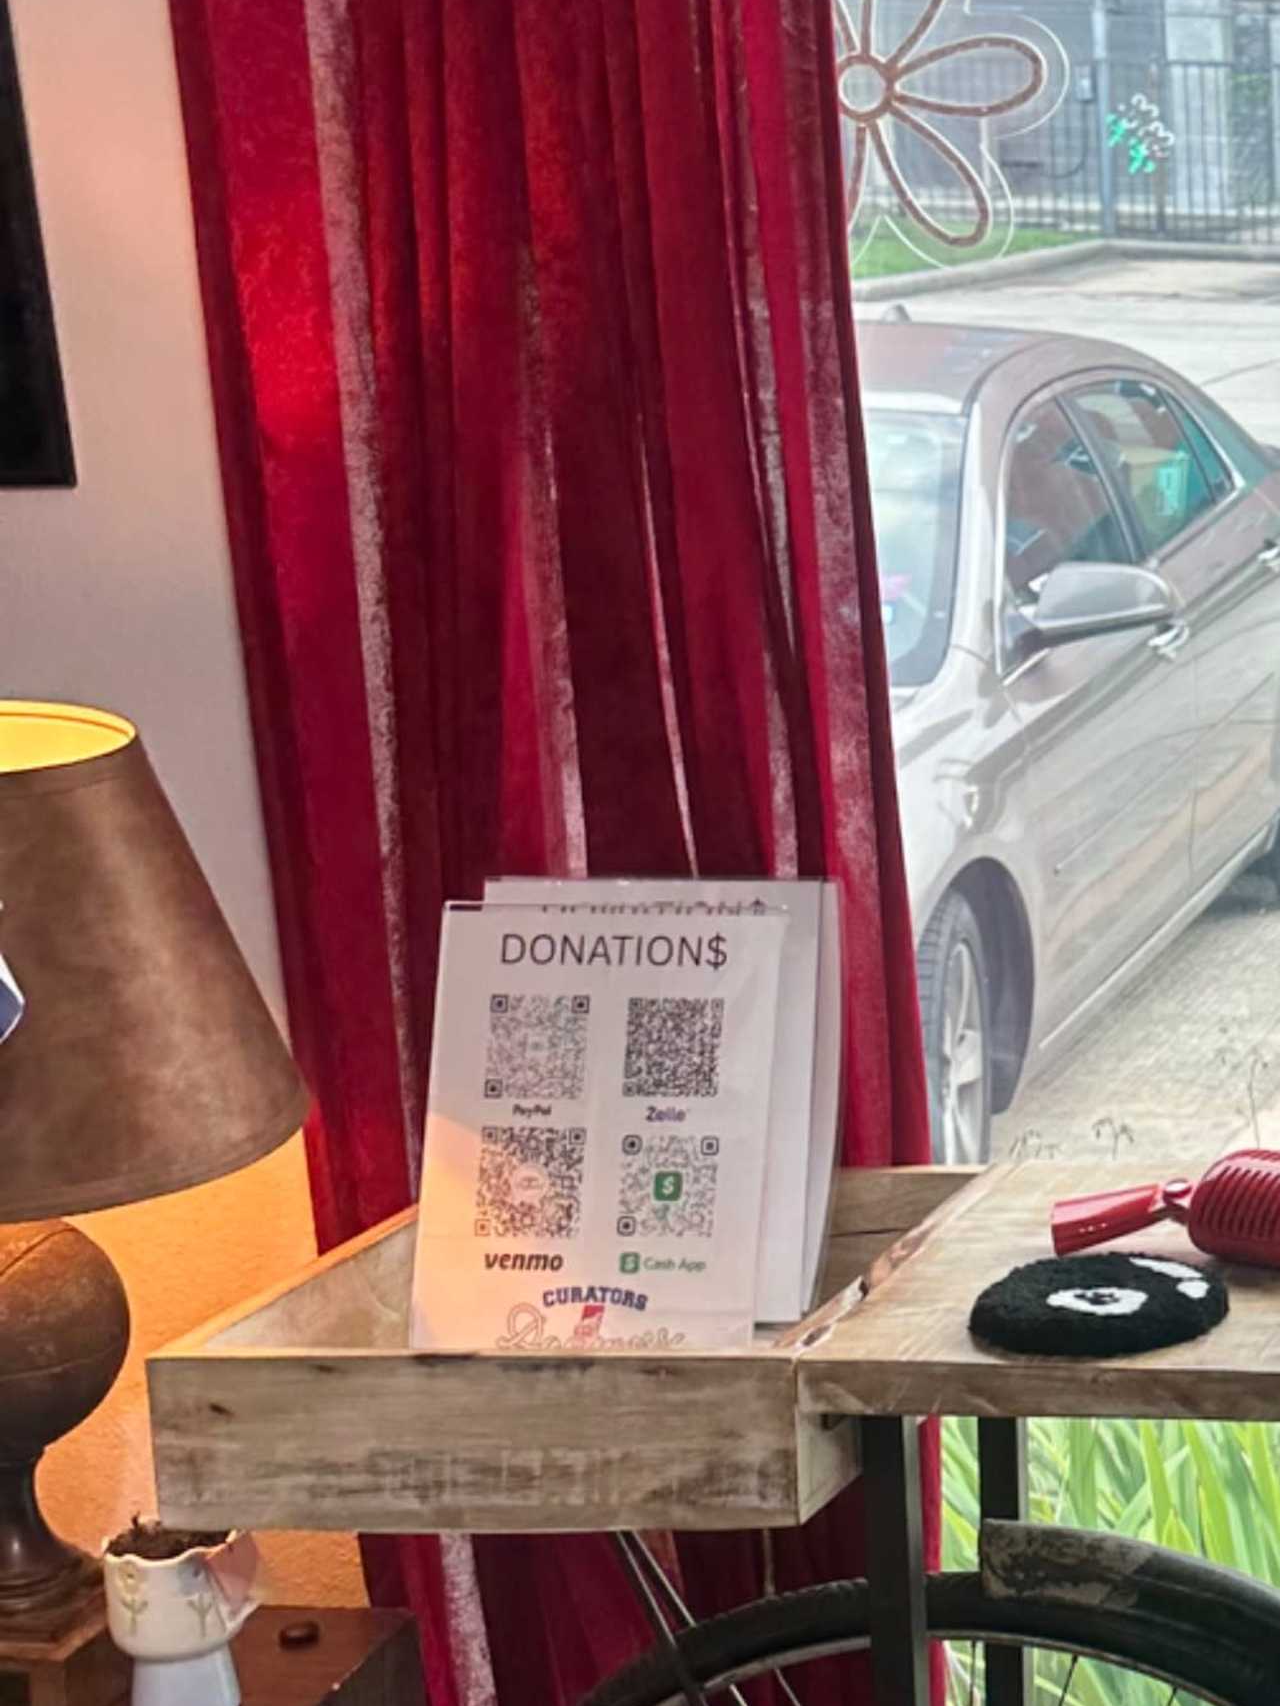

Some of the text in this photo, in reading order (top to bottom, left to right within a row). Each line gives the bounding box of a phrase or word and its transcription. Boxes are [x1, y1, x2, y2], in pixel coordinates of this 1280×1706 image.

[500, 933, 728, 971] DONATION$
[511, 1103, 553, 1119] PayPal
[645, 1106, 687, 1123] Zelle
[483, 1252, 564, 1273] venmo
[643, 1256, 676, 1271] Cash
[678, 1258, 707, 1273] App
[542, 1285, 649, 1312] CURATORS
